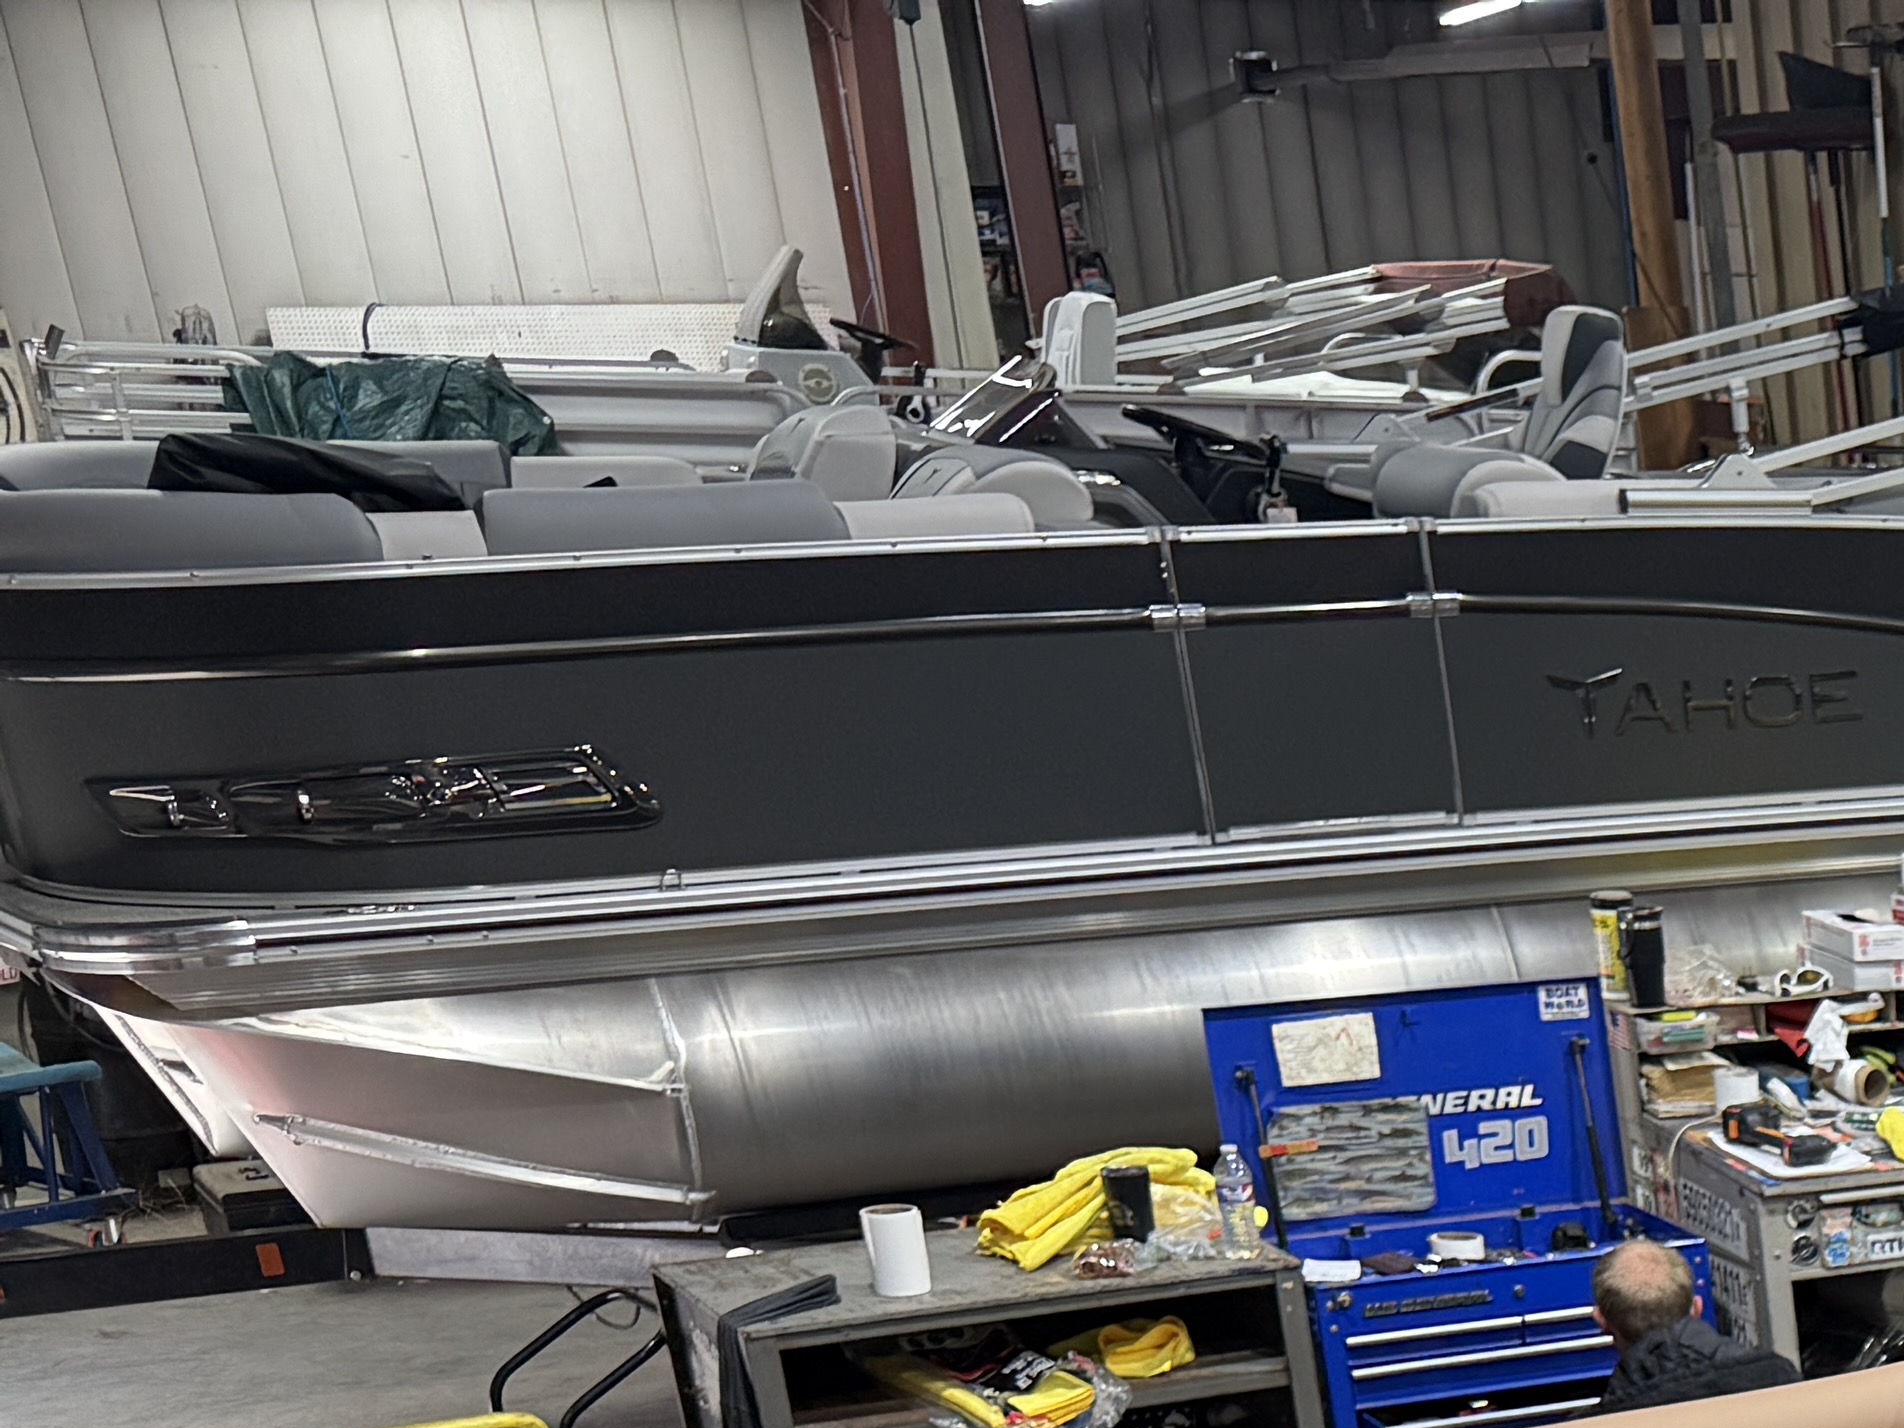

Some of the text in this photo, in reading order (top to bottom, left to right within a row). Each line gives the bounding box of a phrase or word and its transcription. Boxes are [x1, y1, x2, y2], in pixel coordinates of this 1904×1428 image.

[1546, 667, 1863, 739] TAHOE
[1378, 1084, 1543, 1117] NERAL
[1442, 1115, 1549, 1170] 420
